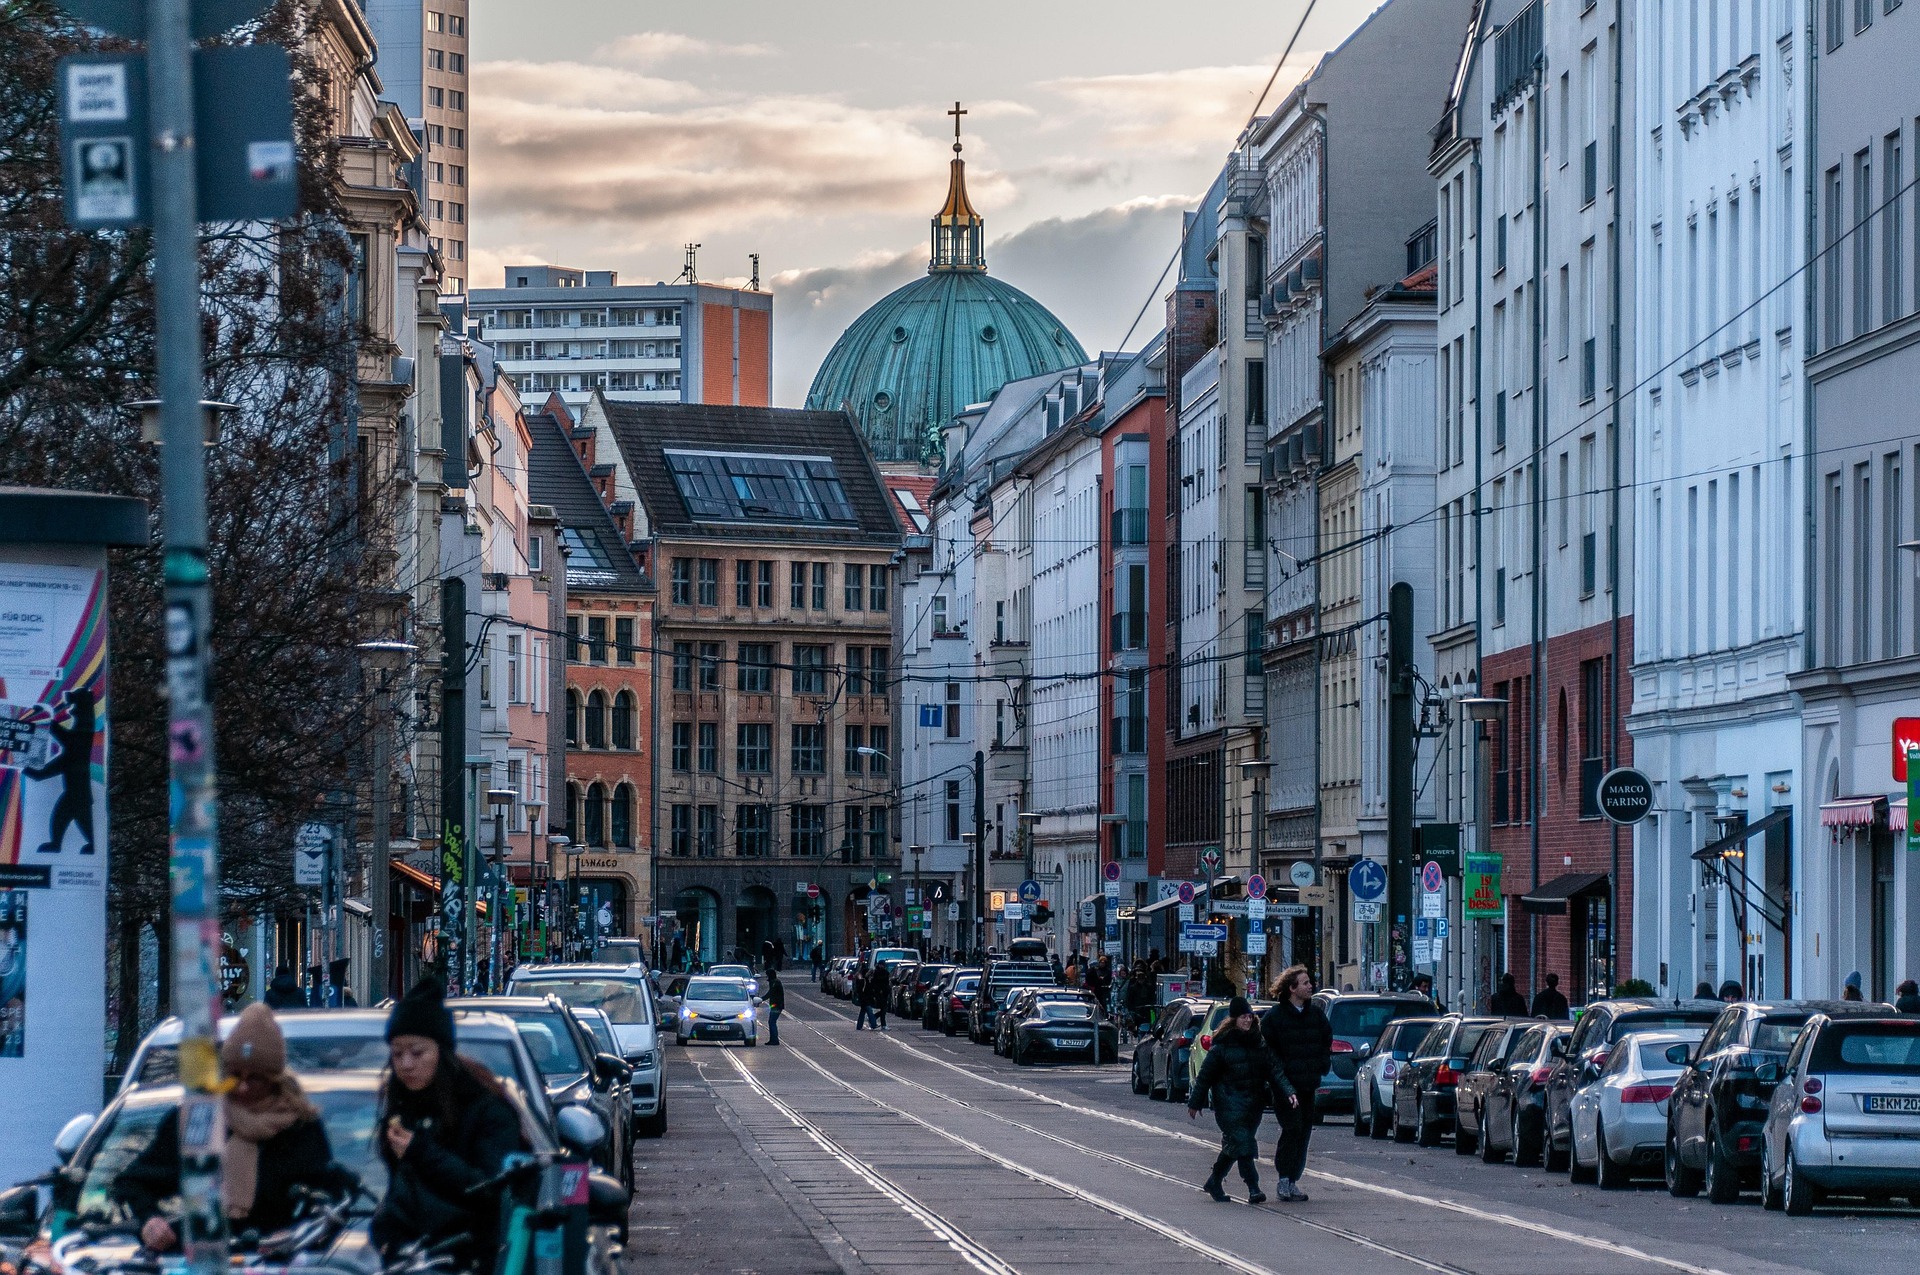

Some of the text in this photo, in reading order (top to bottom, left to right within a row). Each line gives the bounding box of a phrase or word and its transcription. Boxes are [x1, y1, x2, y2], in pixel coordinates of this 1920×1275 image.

[2, 611, 44, 622] FÜR DICH.
[1609, 785, 1644, 793] MARCO
[1607, 797, 1647, 806] FARINO
[305, 821, 320, 834] 23
[743, 869, 772, 884] COS
[1265, 906, 1306, 914] Mulackstraße
[1253, 920, 1261, 932] P
[1438, 920, 1446, 933] P
[1871, 1097, 1879, 1108] B
[1886, 1098, 1902, 1109] KM
